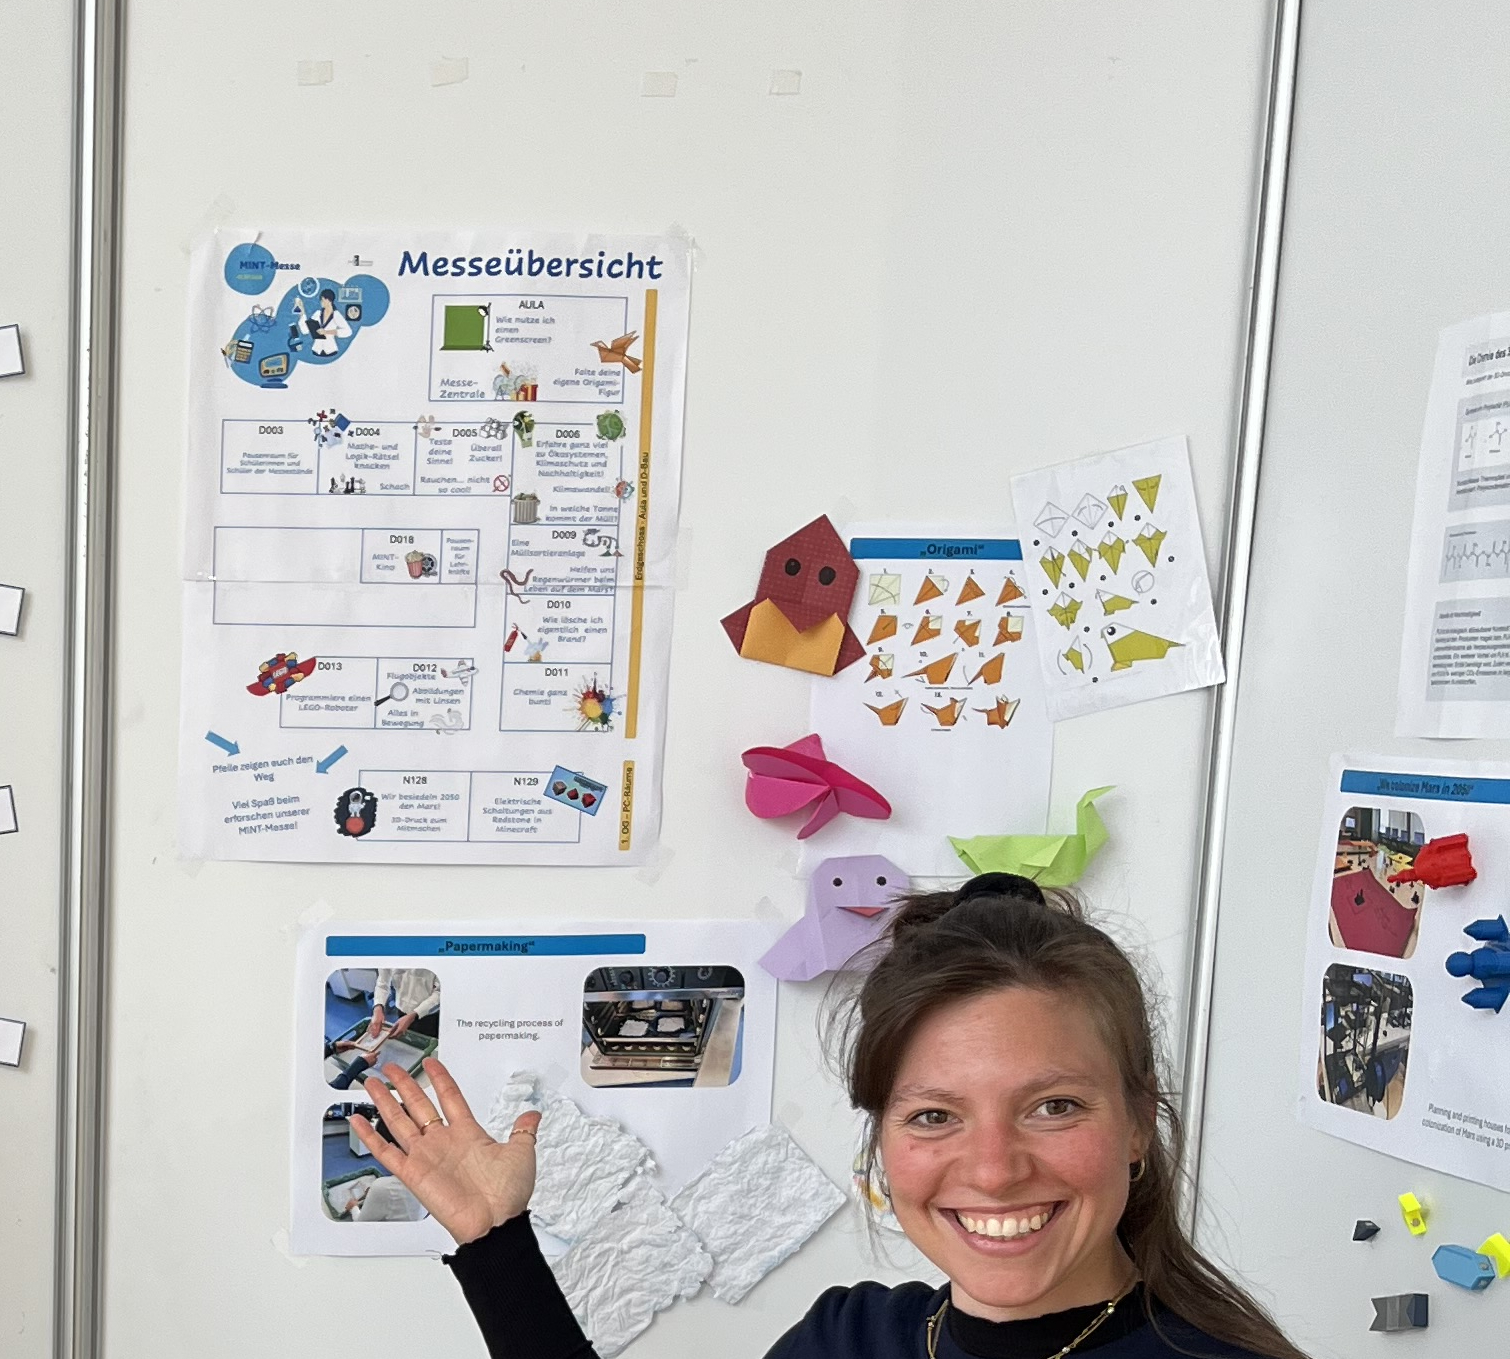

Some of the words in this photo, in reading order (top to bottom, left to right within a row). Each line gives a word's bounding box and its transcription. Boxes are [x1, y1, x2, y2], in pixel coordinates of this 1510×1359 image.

[240, 260, 301, 271] MINT-Messe
[398, 248, 663, 280] Messeübersicht
[519, 300, 545, 309] AULA
[440, 389, 486, 399] Zentrale
[258, 425, 284, 435] D003
[355, 427, 380, 436] D004
[452, 428, 478, 438] D005
[555, 429, 580, 439] D006
[389, 534, 415, 544] D018
[552, 530, 577, 540] D009
[546, 600, 572, 609] D010
[318, 661, 343, 671] D013
[412, 663, 438, 673] D012
[545, 667, 569, 677] D011
[253, 772, 275, 782] Weg
[402, 775, 428, 785] N128
[513, 777, 539, 786] N129
[457, 1019, 473, 1027] The
[475, 1020, 515, 1029] recycling
[517, 1020, 553, 1028] process
[555, 1019, 564, 1027] of
[479, 1032, 539, 1041] papermaking.
